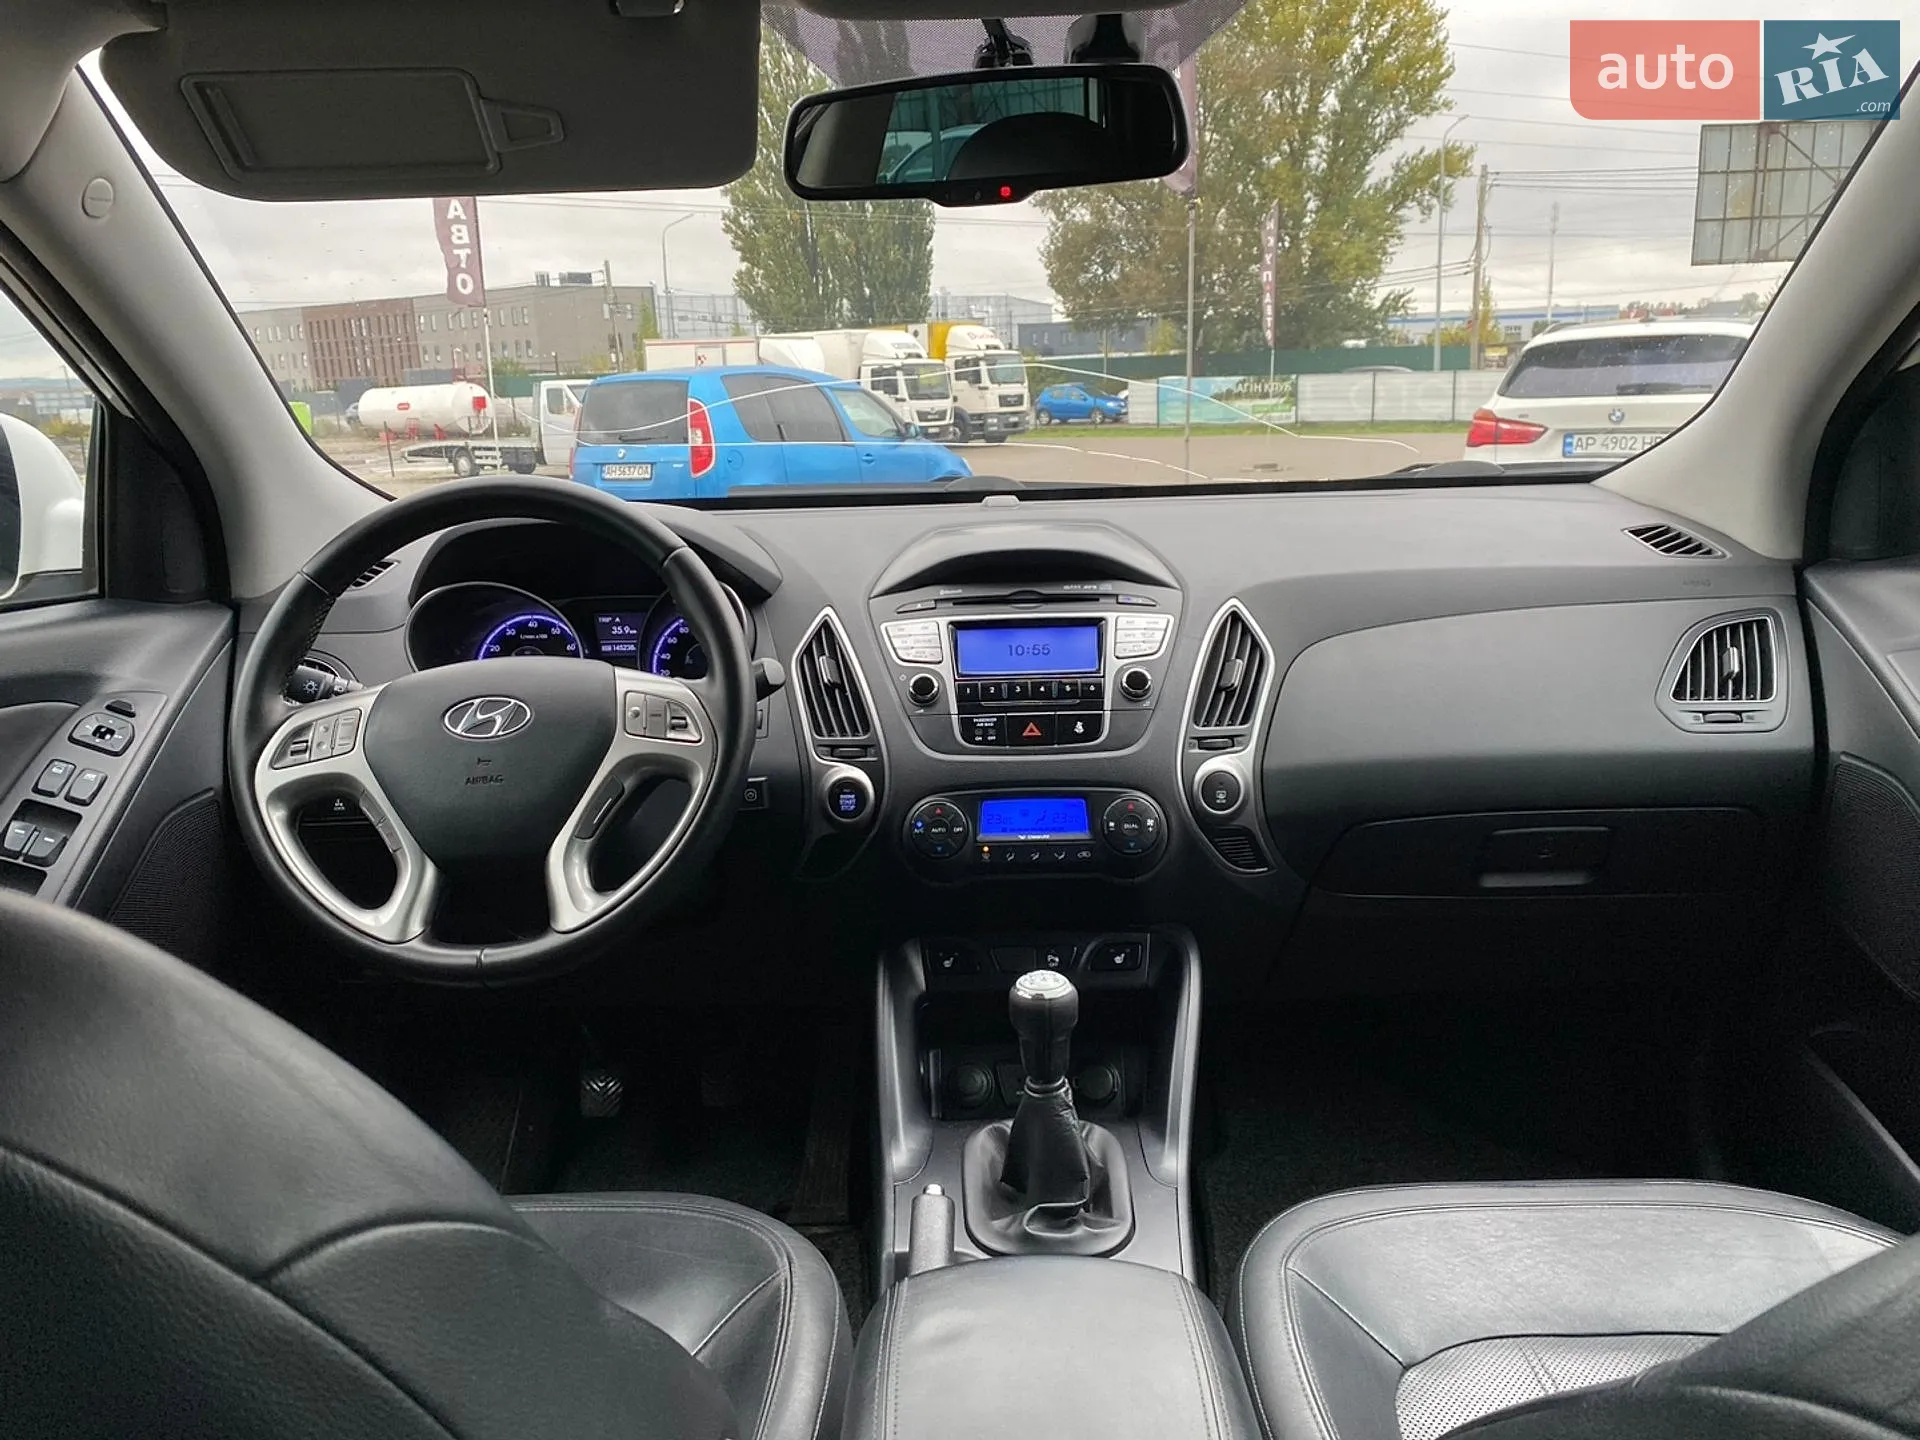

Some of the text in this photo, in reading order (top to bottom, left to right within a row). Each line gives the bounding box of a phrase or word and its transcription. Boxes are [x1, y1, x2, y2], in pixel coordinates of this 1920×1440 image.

[1574, 436, 1597, 451] AP
[1600, 435, 1637, 451] 4902
[1008, 643, 1051, 656] 10:55
